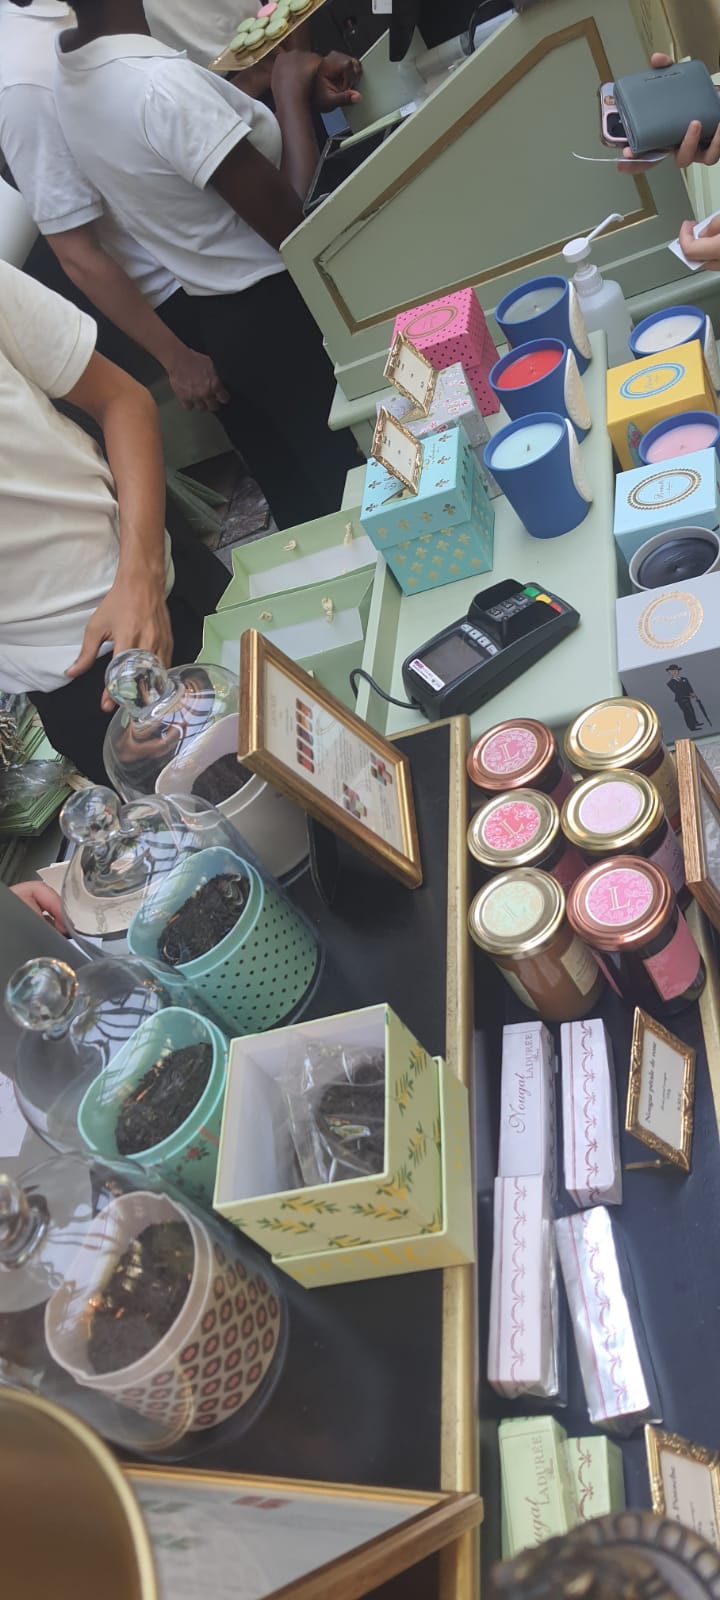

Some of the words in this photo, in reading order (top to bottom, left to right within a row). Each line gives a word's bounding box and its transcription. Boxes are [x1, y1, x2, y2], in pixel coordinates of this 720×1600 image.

[499, 742, 520, 762] L
[499, 819, 525, 838] L
[609, 886, 632, 911] L
[530, 1435, 551, 1505] LADURÉE
[524, 1496, 549, 1545] ugat
